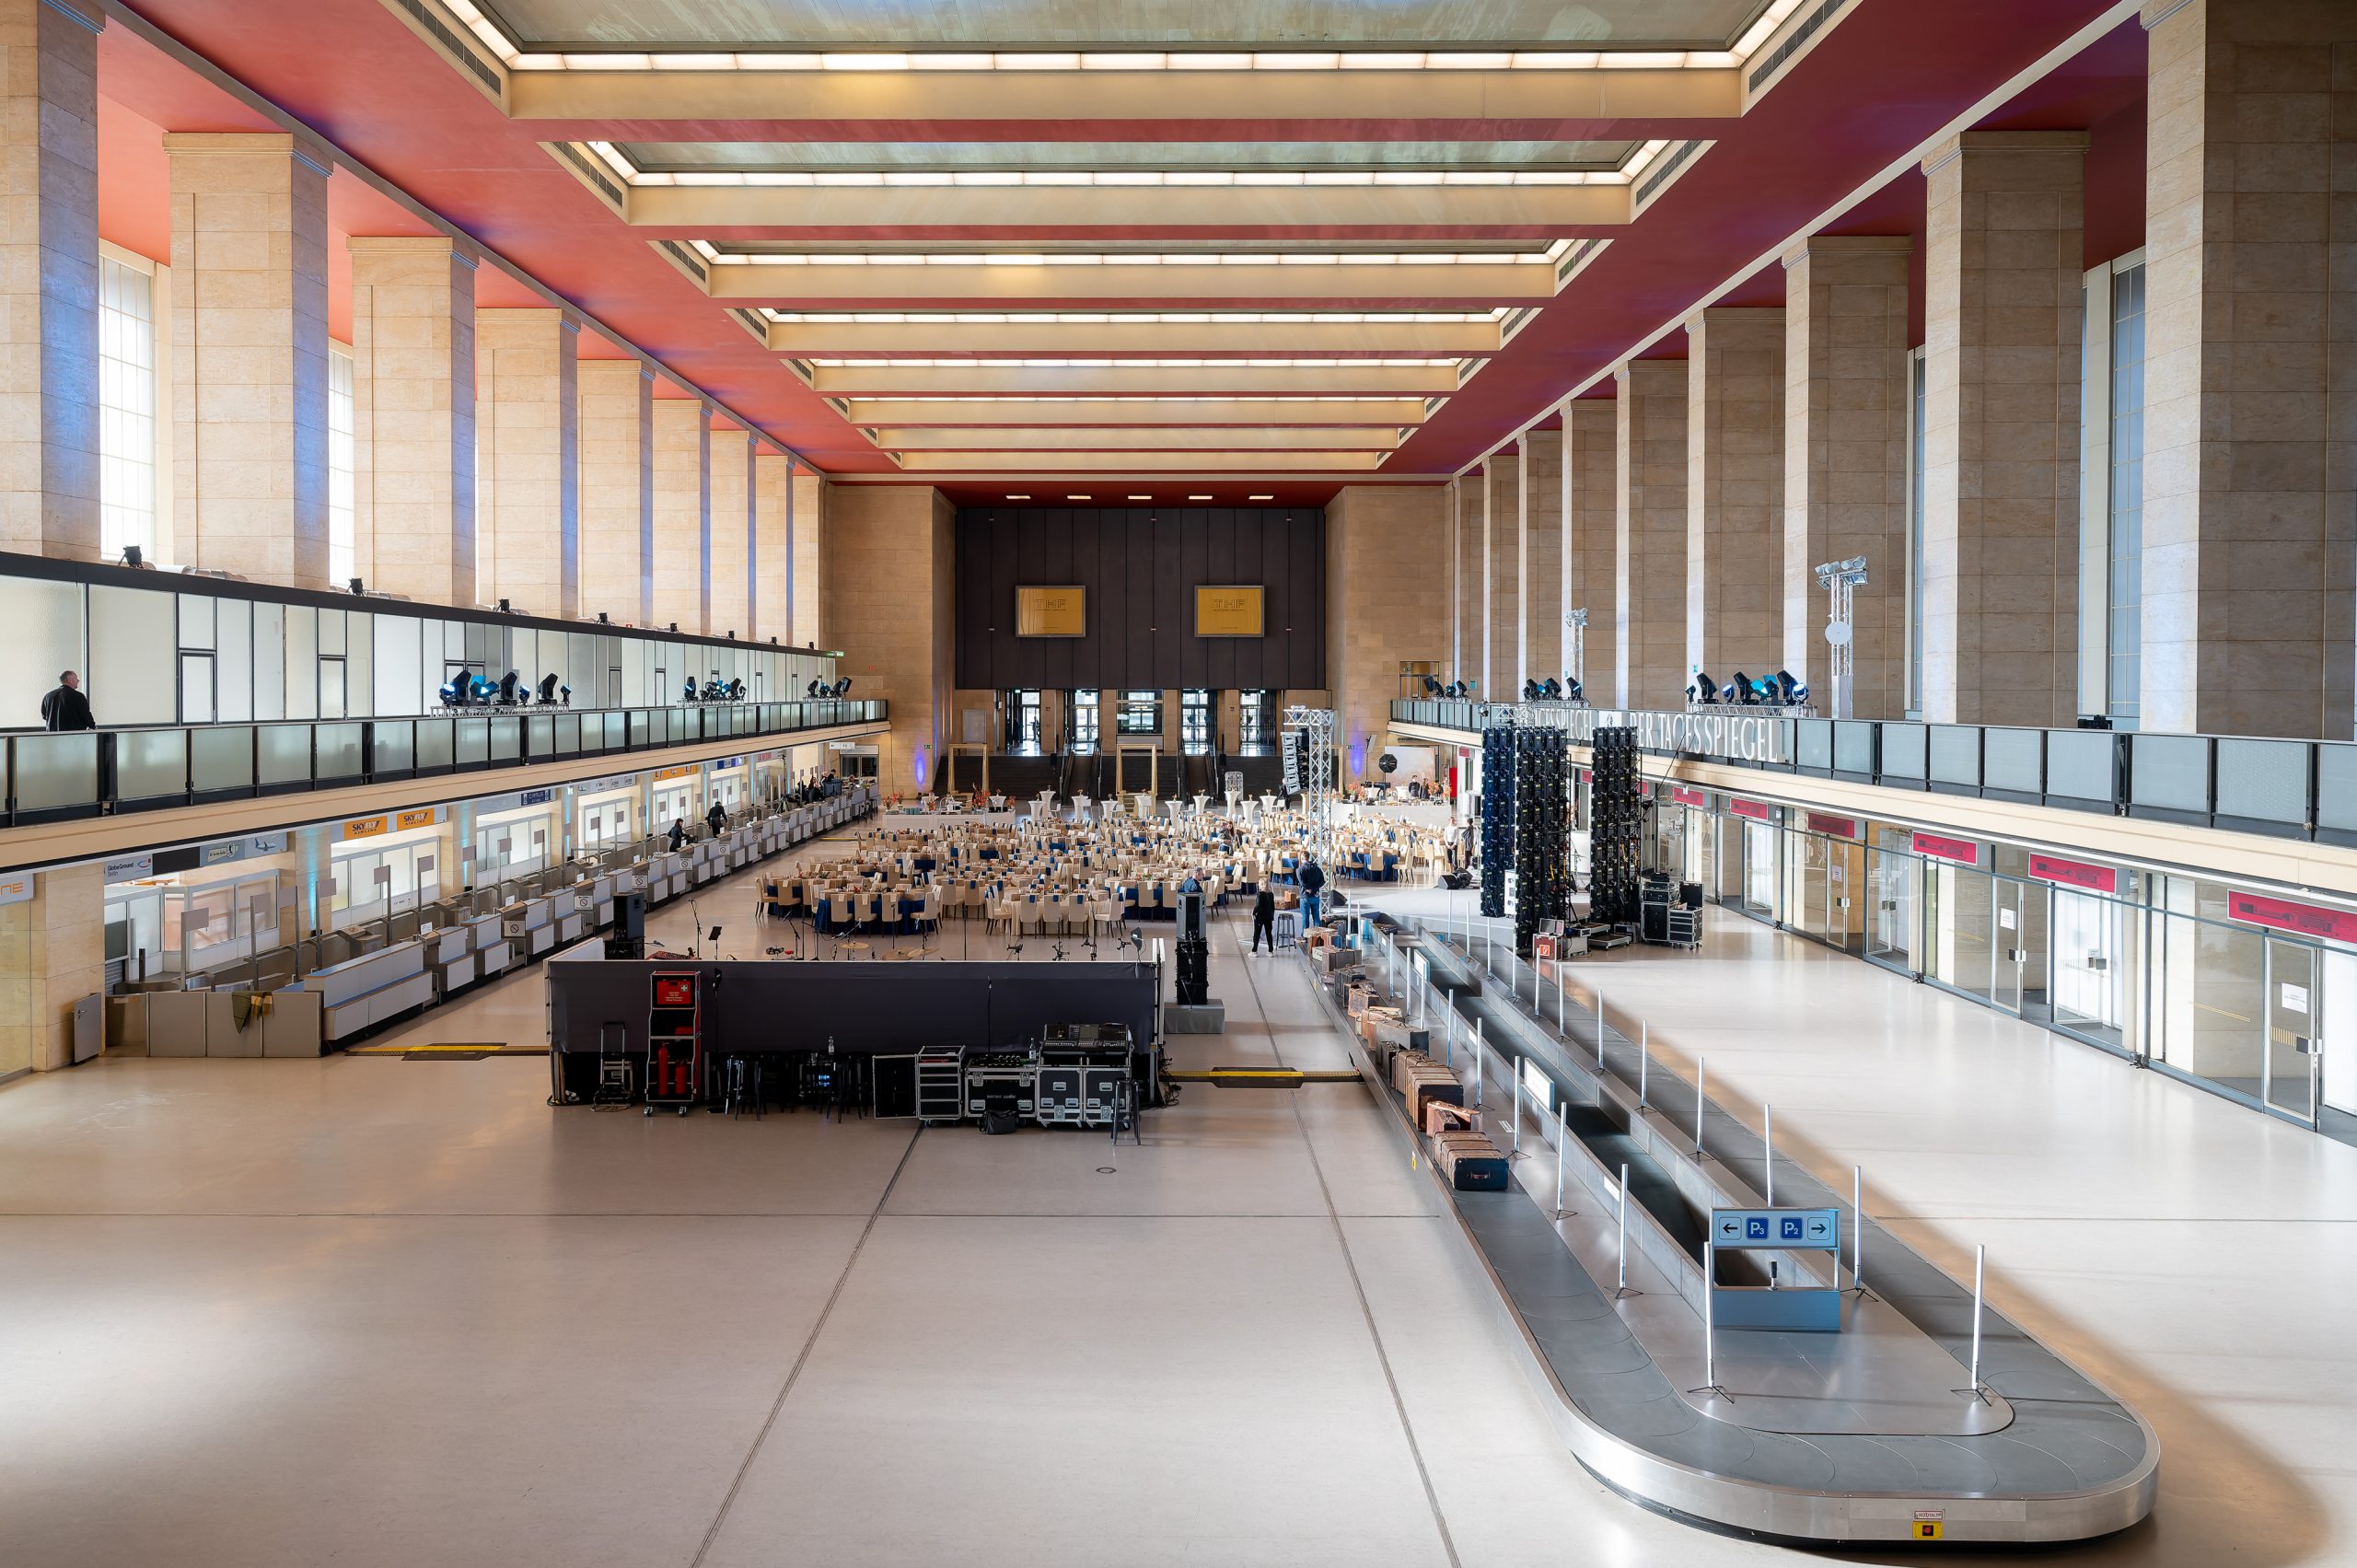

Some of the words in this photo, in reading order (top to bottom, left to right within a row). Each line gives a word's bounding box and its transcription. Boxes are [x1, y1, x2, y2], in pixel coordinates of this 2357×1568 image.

[1035, 598, 1067, 609] THF
[1213, 598, 1246, 609] THF
[1658, 714, 1778, 762] TAGESSPIEGEL
[1750, 1222, 1765, 1236] P3
[1784, 1222, 1799, 1236] P2
